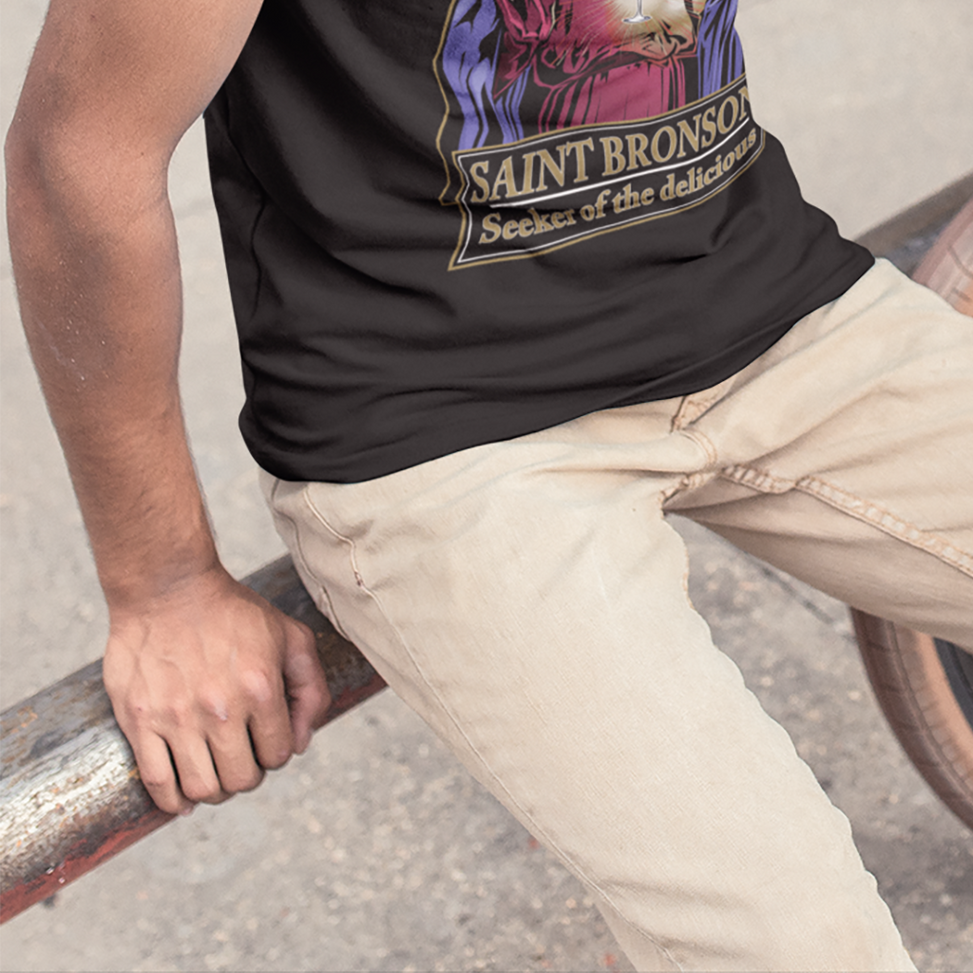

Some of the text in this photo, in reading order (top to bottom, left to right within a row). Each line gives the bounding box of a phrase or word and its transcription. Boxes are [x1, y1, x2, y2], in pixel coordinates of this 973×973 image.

[469, 137, 594, 204] SAINT
[478, 128, 757, 245] Seeker of the delicious
